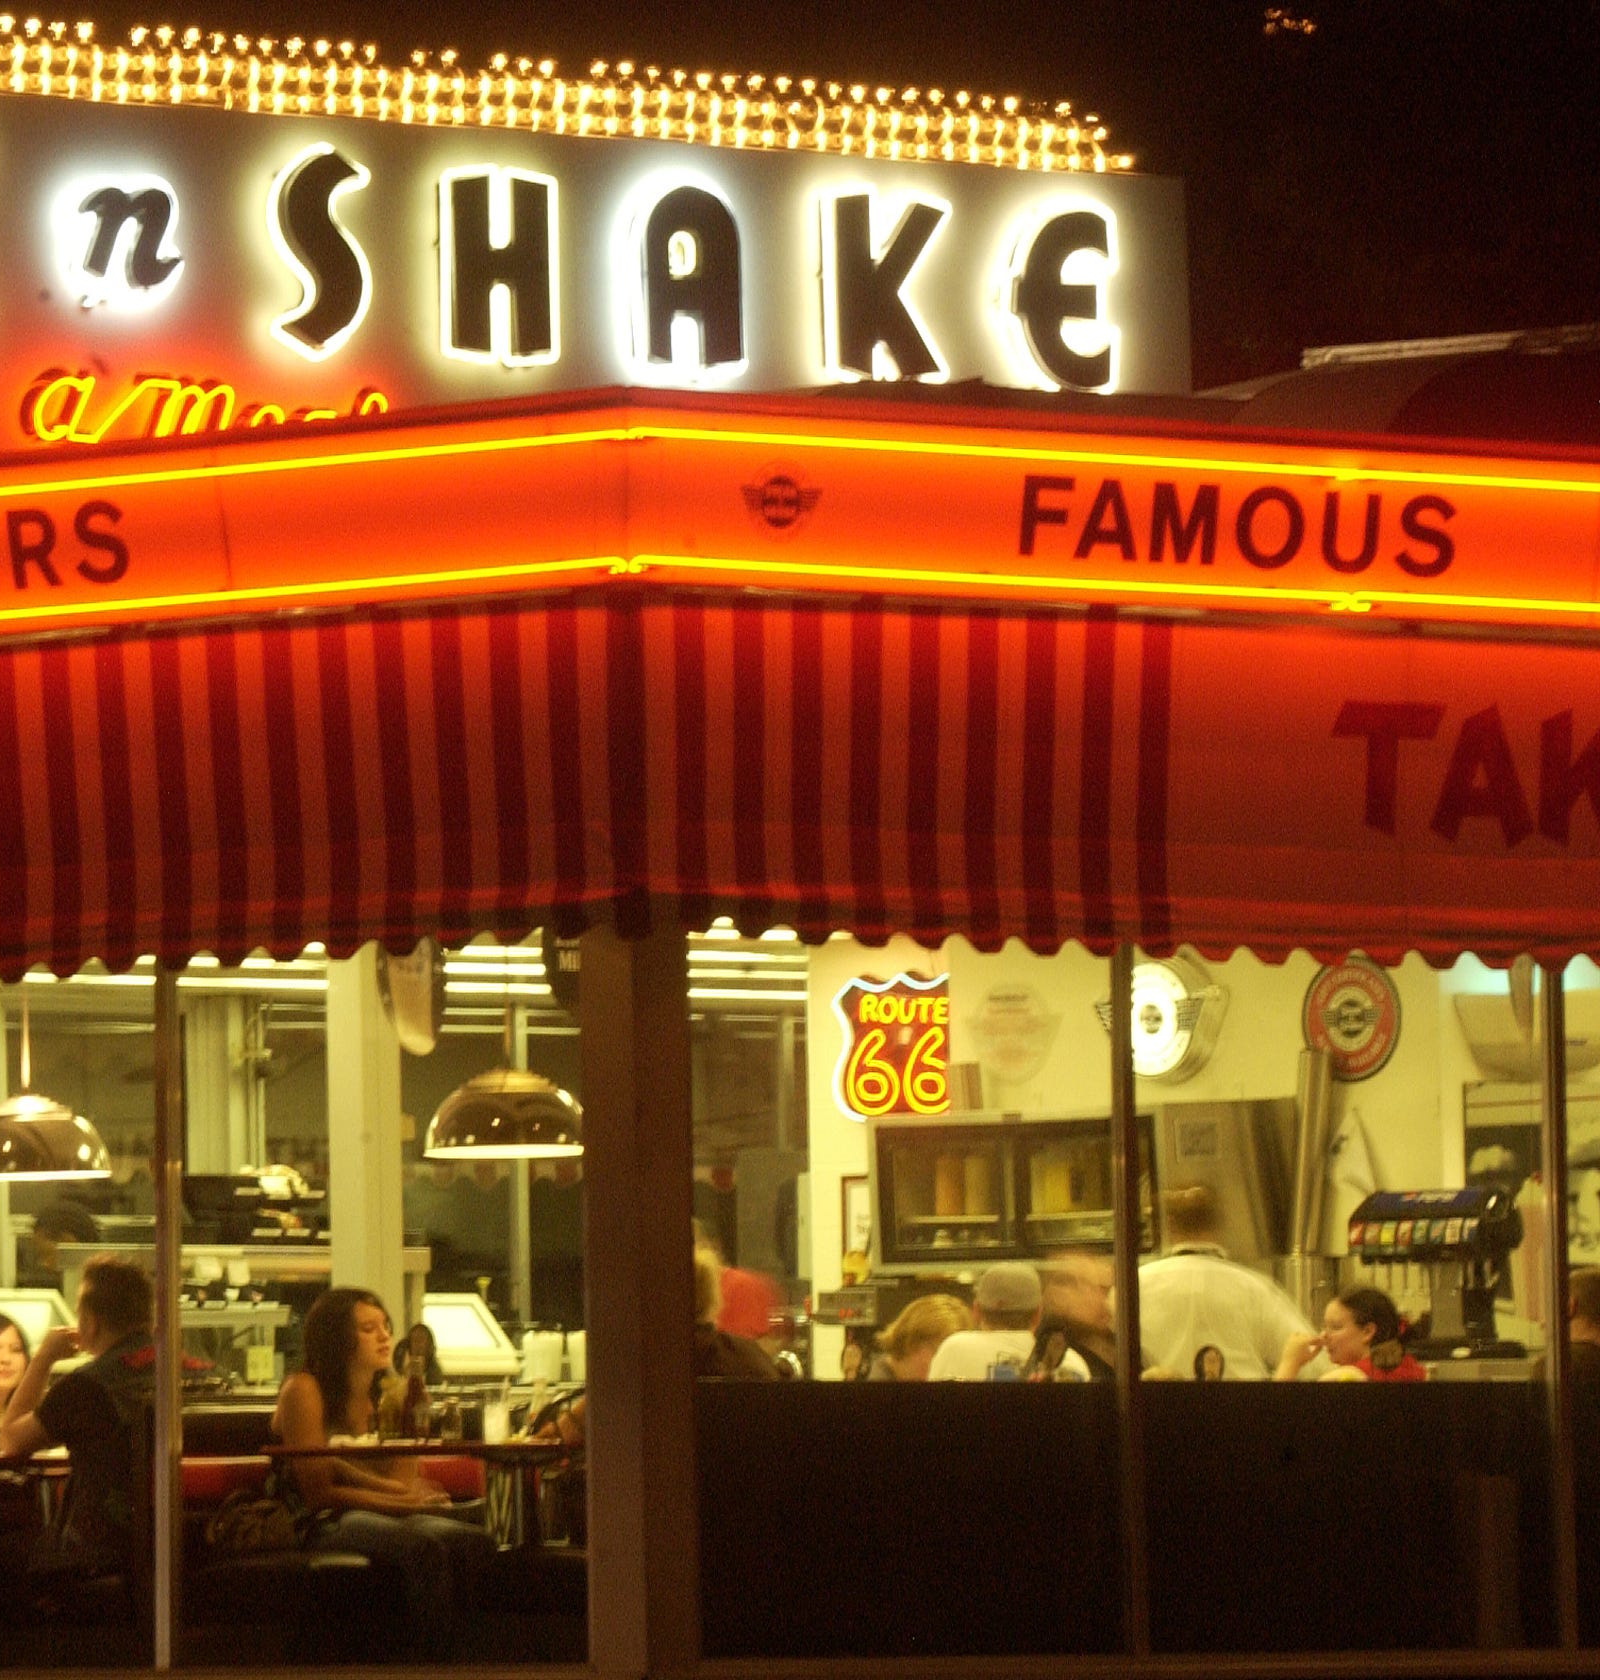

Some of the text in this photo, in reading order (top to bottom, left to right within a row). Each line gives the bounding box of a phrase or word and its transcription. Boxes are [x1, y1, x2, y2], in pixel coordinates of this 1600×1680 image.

[50, 172, 184, 302] n
[266, 141, 1120, 394] SHAKE
[1017, 474, 1457, 578] FAMOUS
[859, 993, 949, 1025] ROUTE
[846, 1026, 949, 1116] 66
